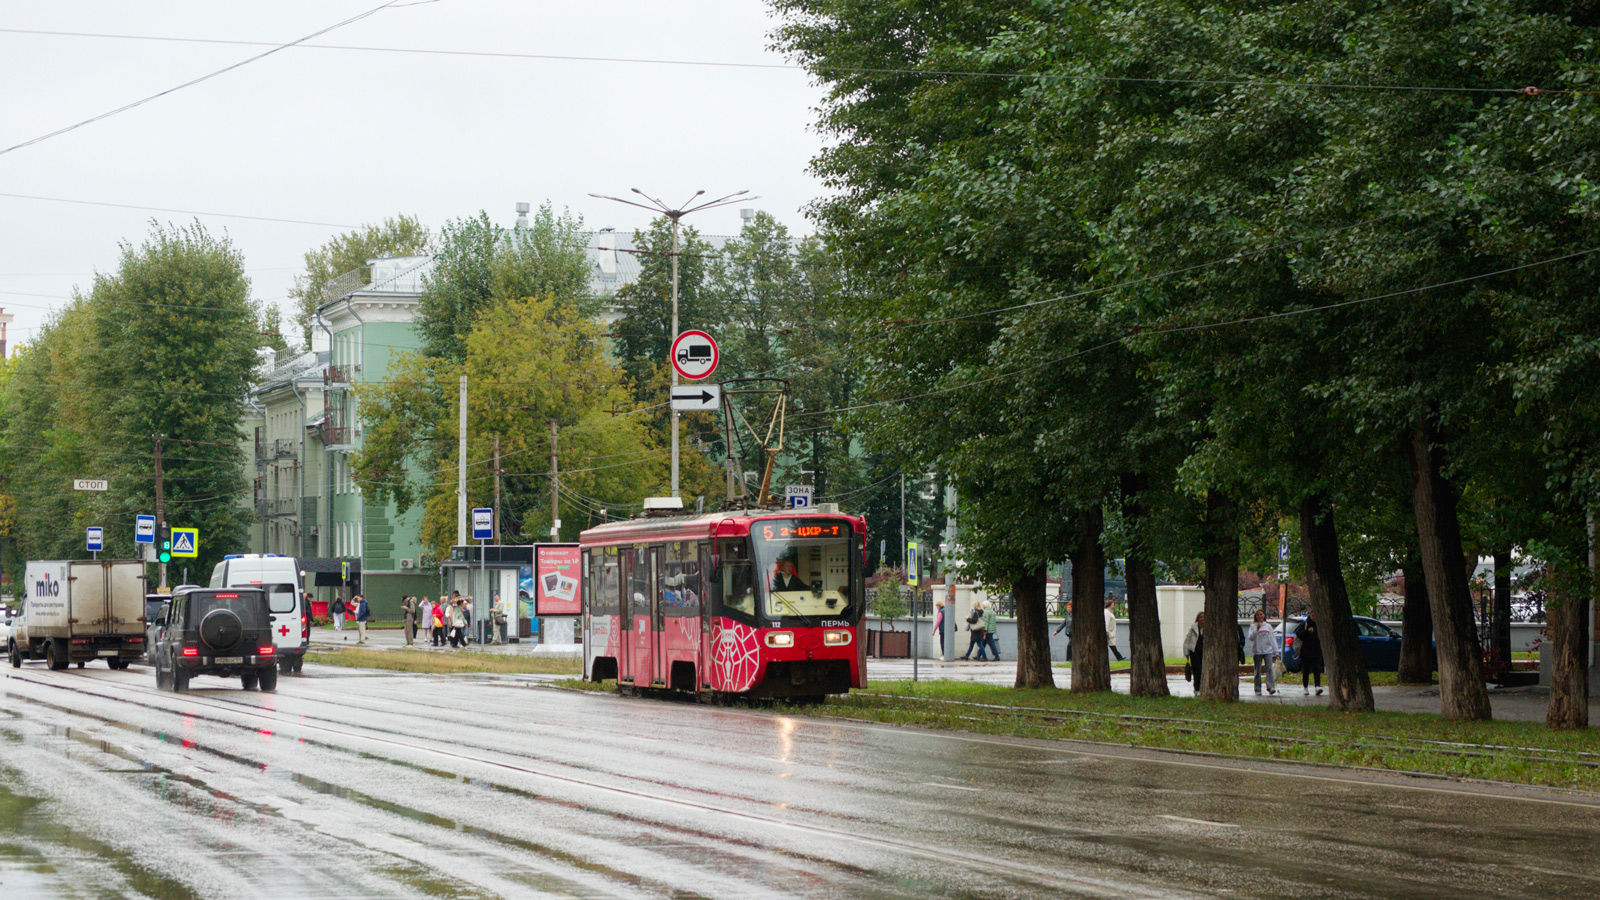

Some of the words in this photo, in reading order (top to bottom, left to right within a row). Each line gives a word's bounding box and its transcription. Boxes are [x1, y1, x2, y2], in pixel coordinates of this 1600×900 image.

[78, 481, 103, 489] СТОП
[794, 497, 806, 508] P
[763, 526, 774, 540] 5
[36, 572, 60, 597] miko
[774, 601, 783, 612] 5
